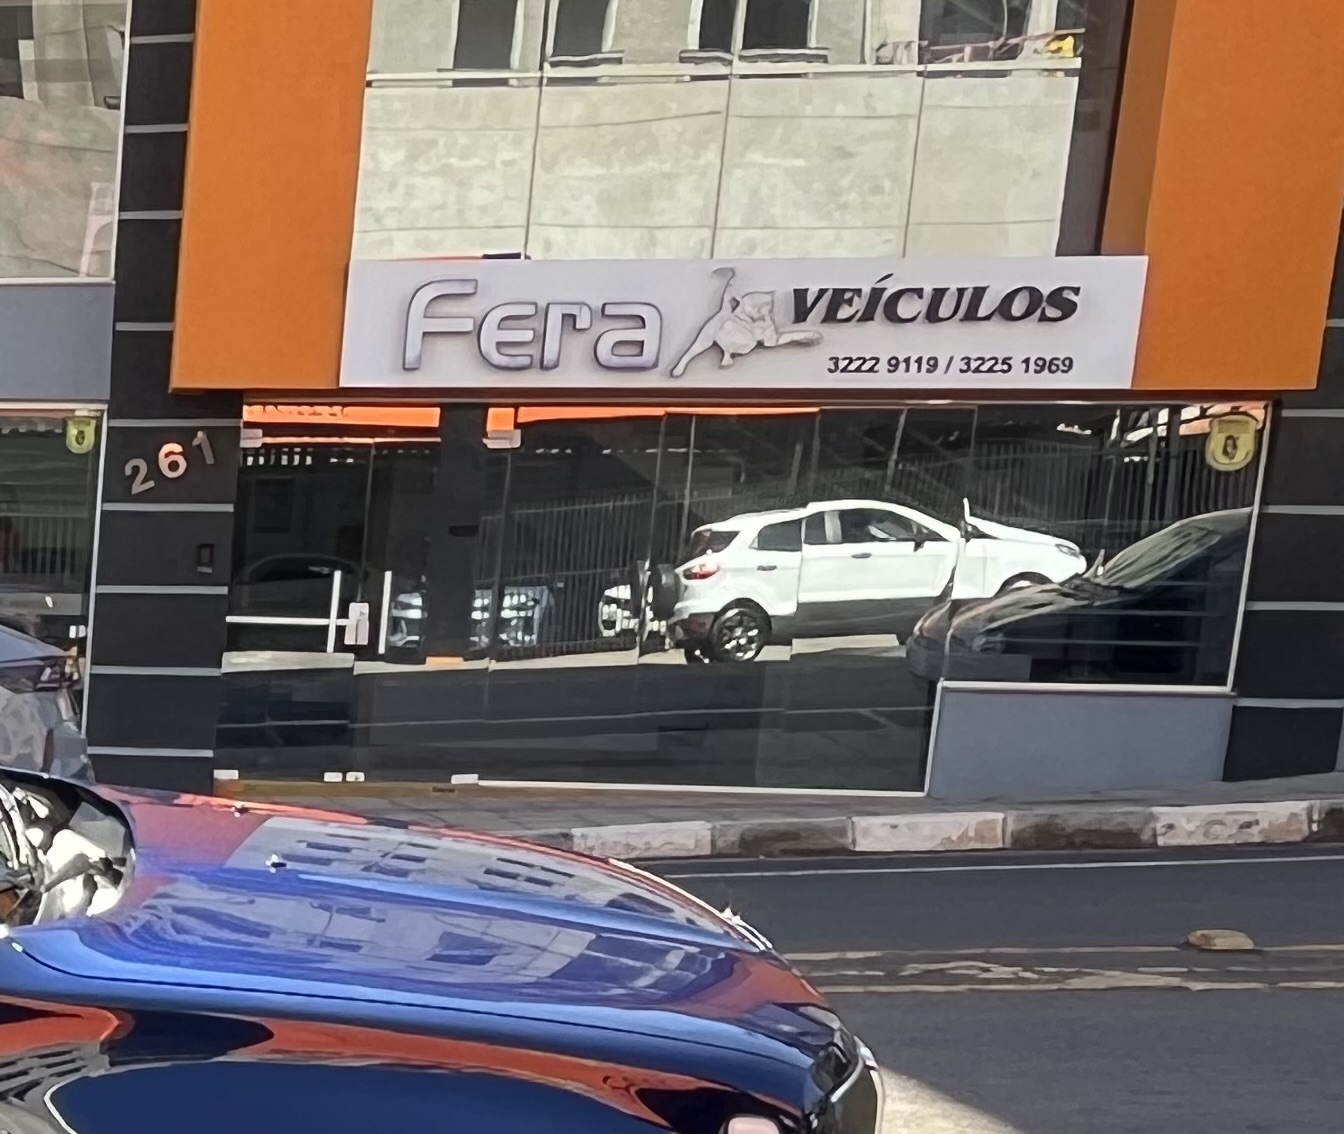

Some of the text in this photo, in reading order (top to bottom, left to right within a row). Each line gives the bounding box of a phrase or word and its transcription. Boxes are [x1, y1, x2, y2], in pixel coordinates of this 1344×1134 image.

[402, 272, 1082, 371] Fera VEÍCULOS
[826, 355, 1074, 375] 3222 9119 / 3225 1969
[124, 429, 214, 495] 261
